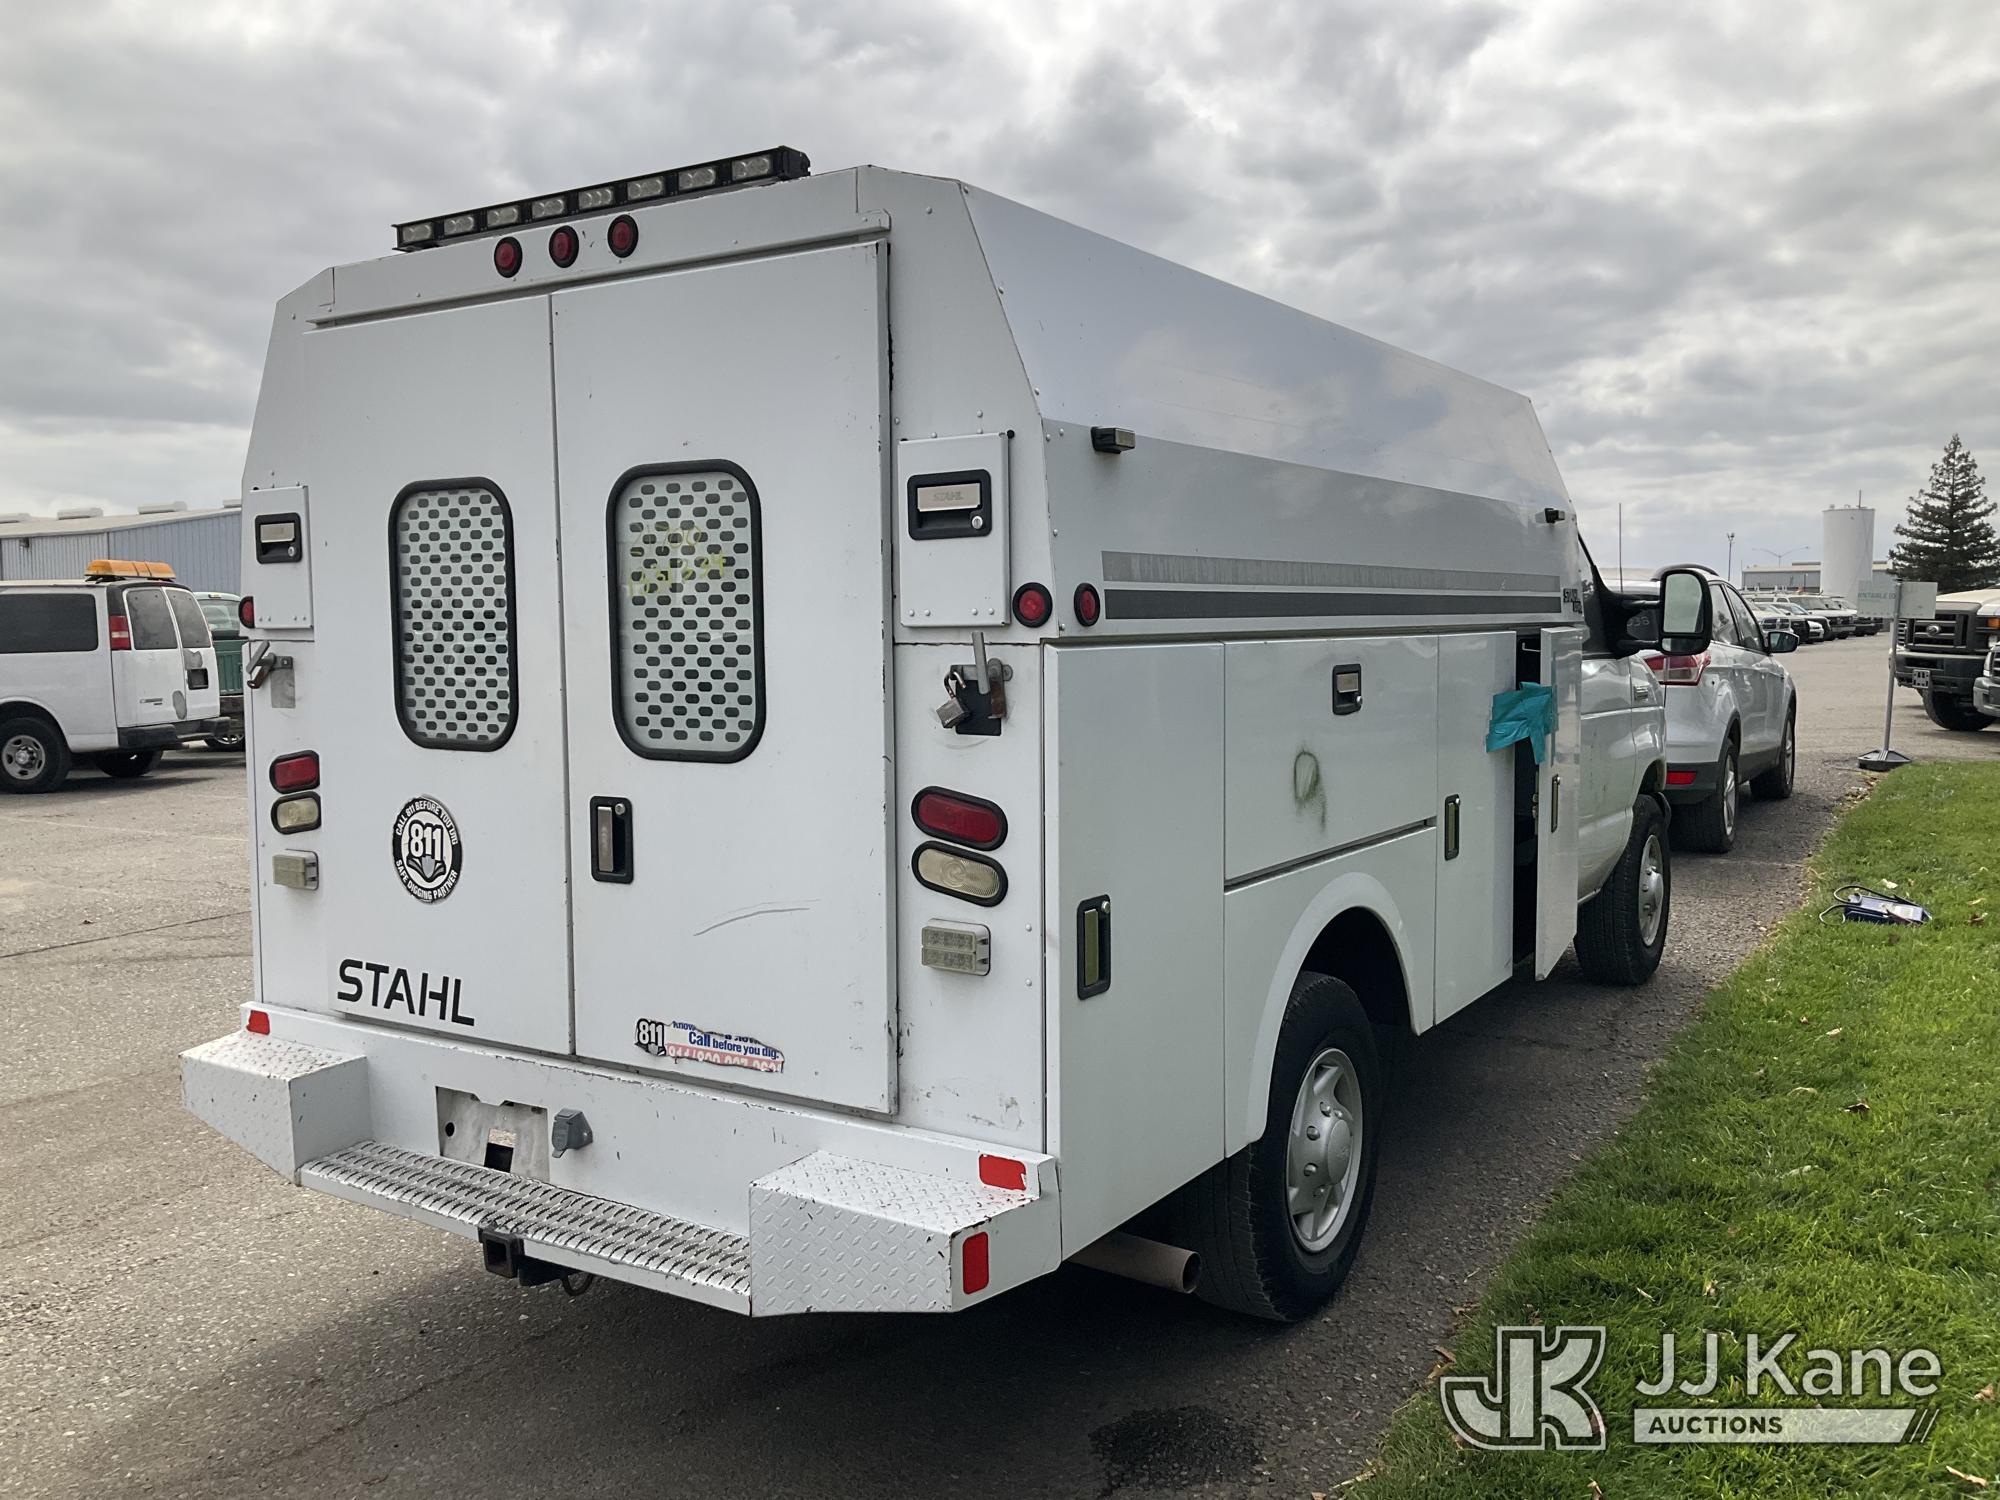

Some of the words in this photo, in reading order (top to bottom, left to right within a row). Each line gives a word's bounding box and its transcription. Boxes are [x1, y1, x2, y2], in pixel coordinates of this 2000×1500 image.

[395, 814, 408, 836] CALL
[406, 805, 416, 818] 811
[415, 801, 440, 815] BEFORE
[449, 826, 459, 846] DIG
[409, 820, 443, 861] 811
[395, 859, 408, 882] SAFE
[407, 879, 433, 900] DIGGING
[432, 869, 459, 900] PARTNER
[337, 958, 475, 1027] STAHL
[637, 1018, 665, 1047] 811
[688, 1031, 711, 1047] Call
[712, 1038, 742, 1053] before
[743, 1045, 761, 1056] you
[762, 1046, 780, 1060] dig.
